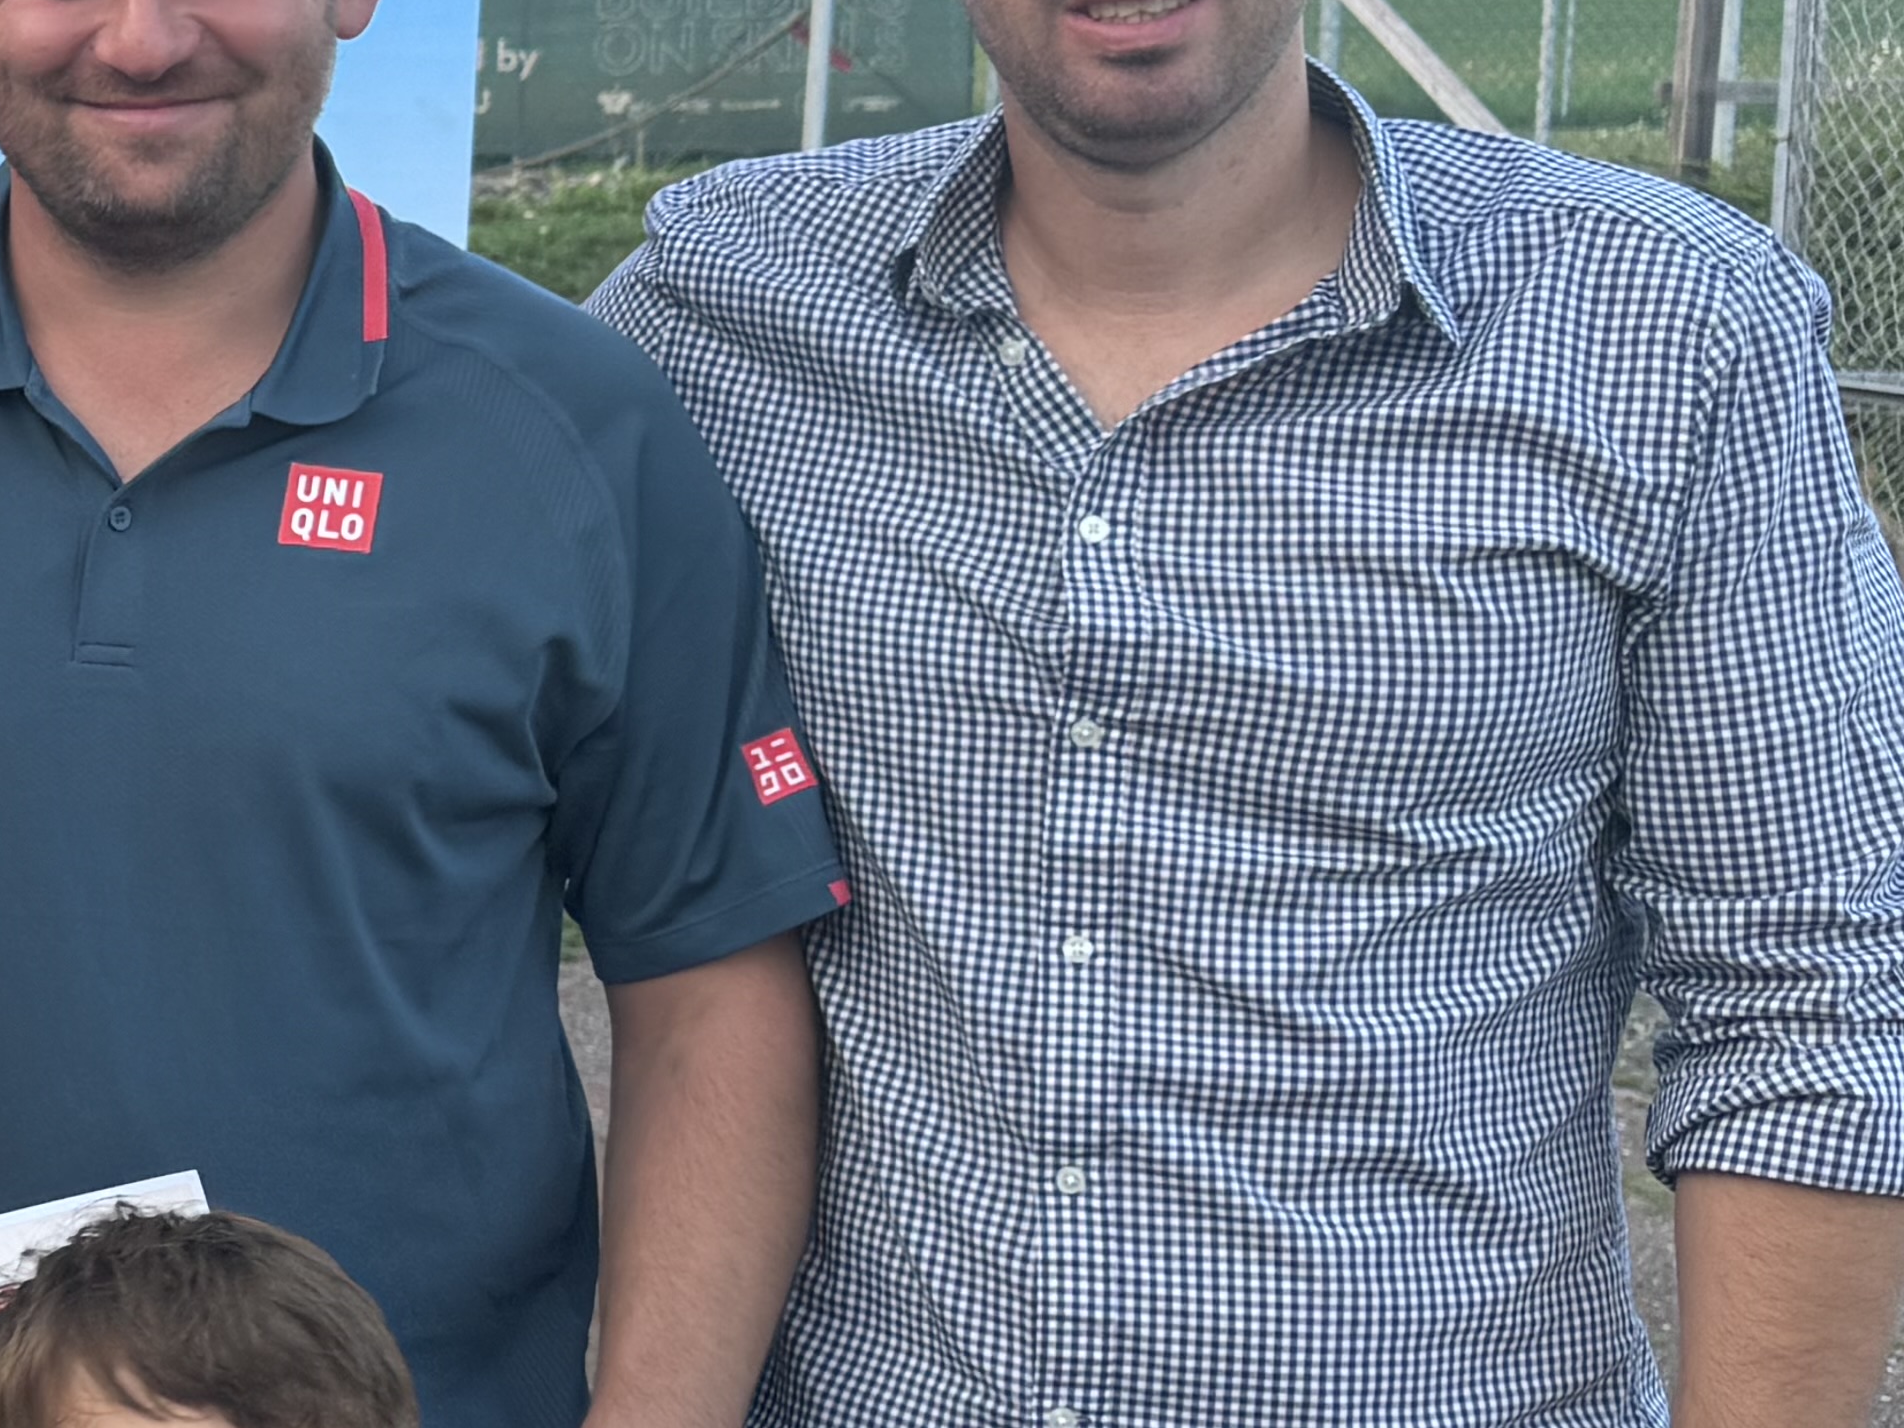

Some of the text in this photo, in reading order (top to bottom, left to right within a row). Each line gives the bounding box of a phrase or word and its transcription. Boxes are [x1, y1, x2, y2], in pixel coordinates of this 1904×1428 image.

[495, 37, 539, 81] by
[296, 473, 365, 509] UNI
[290, 507, 365, 542] QLO
